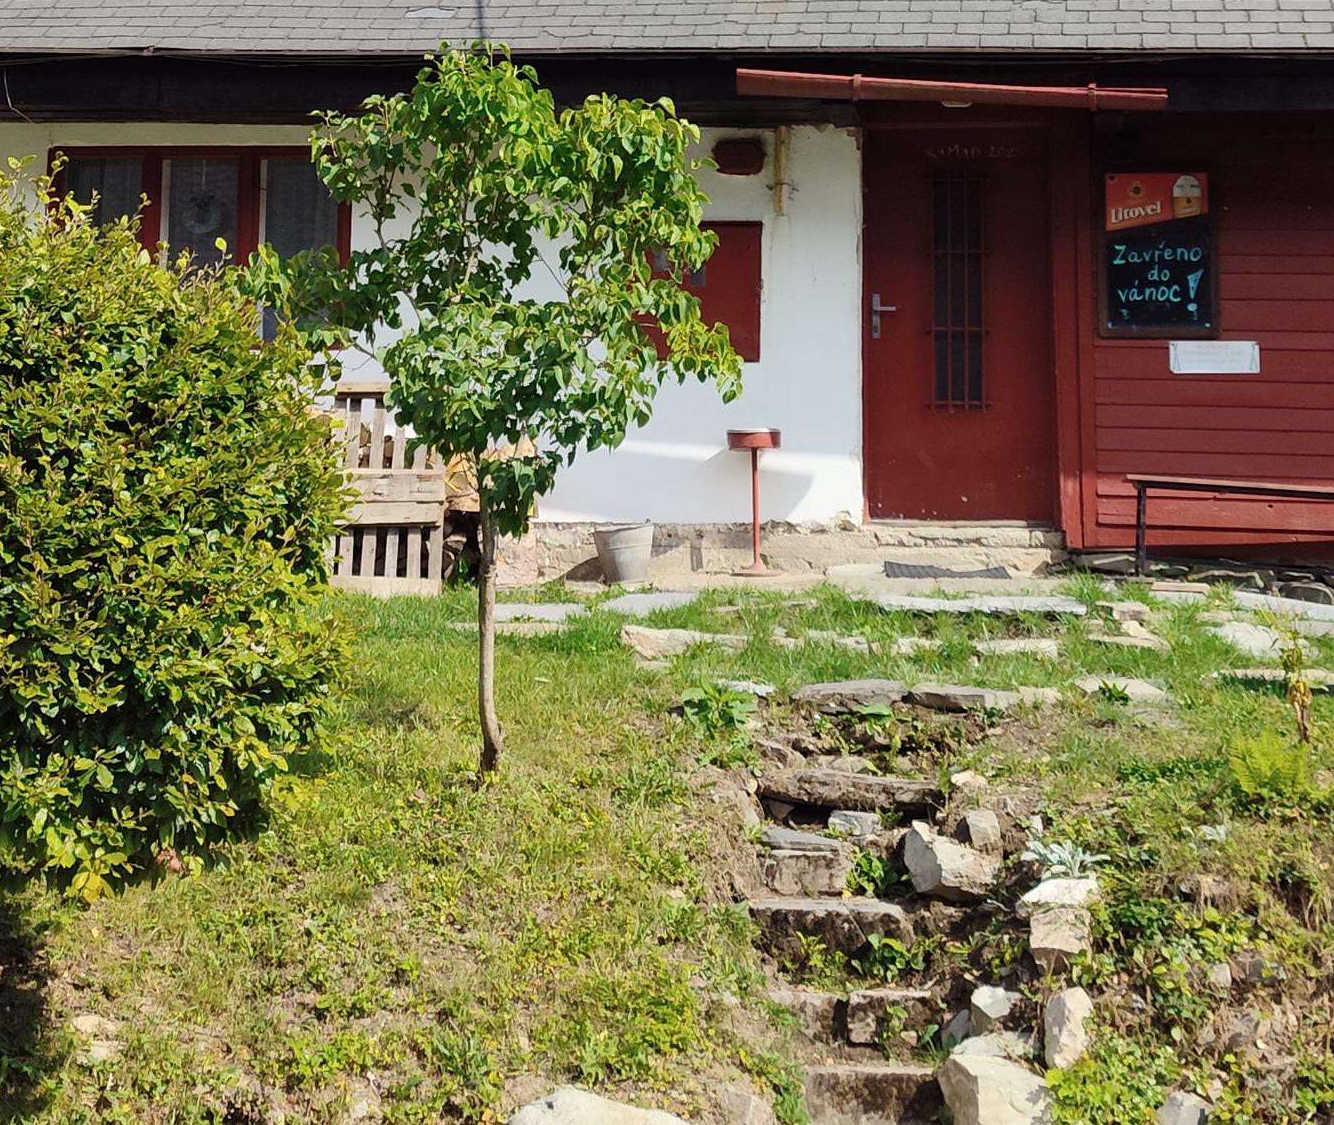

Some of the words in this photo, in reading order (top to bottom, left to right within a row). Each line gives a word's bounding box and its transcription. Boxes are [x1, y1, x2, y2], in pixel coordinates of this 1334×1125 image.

[1110, 201, 1162, 224] Litovel
[1112, 240, 1203, 265] Zavřeno
[1147, 265, 1171, 281] do
